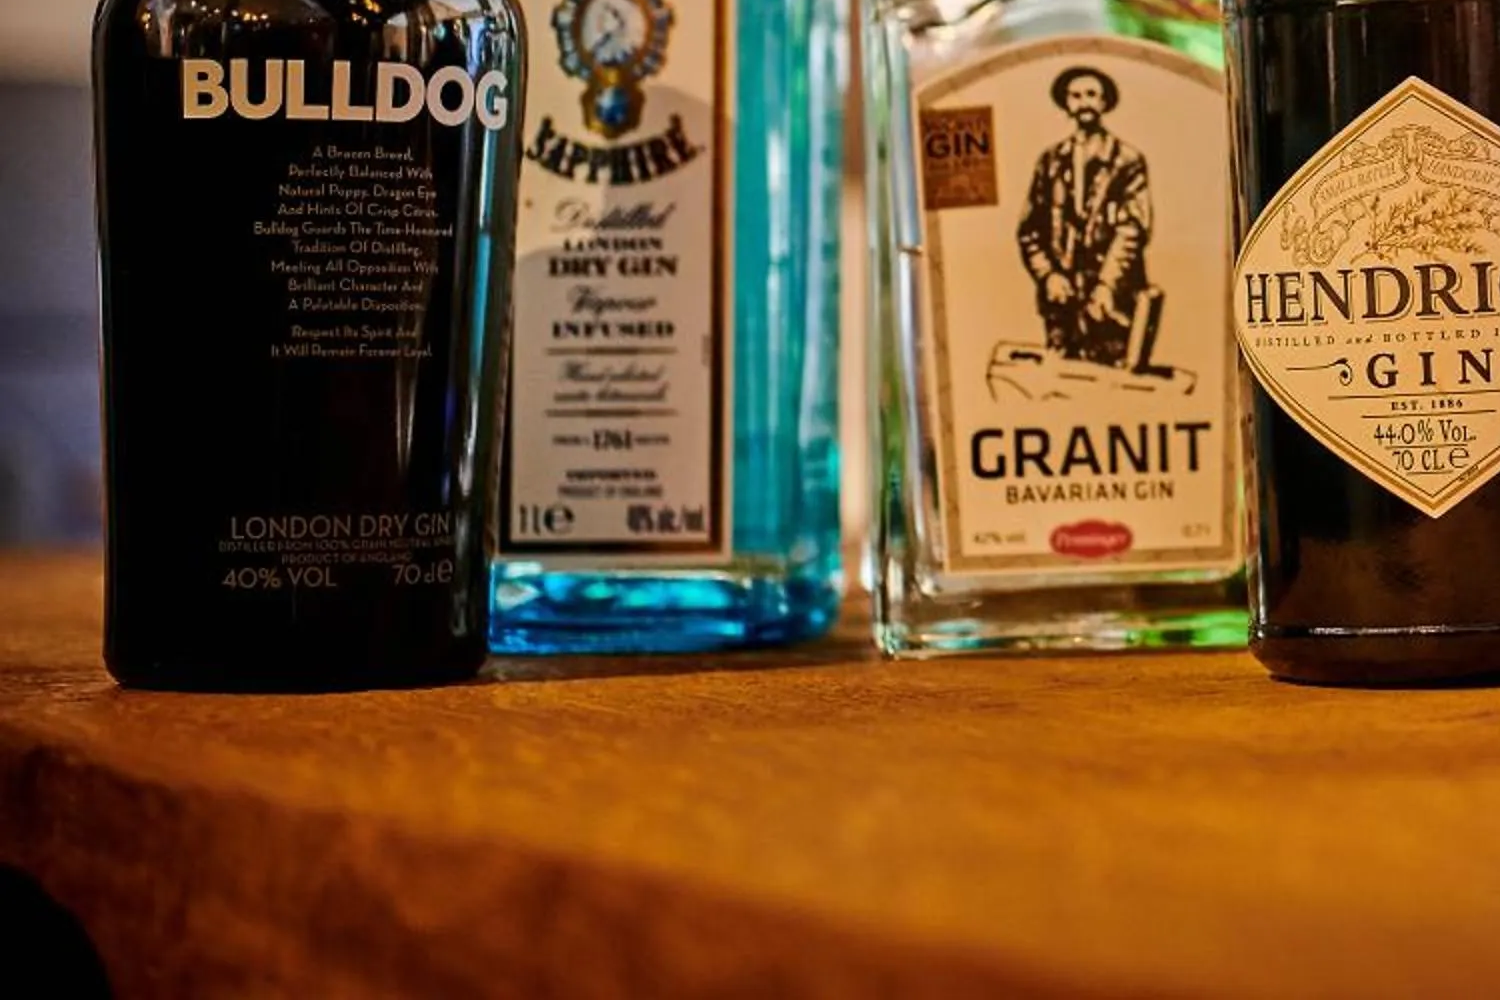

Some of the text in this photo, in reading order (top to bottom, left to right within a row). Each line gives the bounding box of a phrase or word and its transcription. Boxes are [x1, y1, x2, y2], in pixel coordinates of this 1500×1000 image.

[182, 58, 508, 131] BULLDOG
[312, 145, 323, 159] A
[525, 113, 705, 186] SAPPHIRE
[926, 131, 990, 159] GIN
[288, 163, 345, 179] Perfectly
[349, 164, 404, 179] Balanced
[278, 184, 325, 198] Natural
[307, 203, 341, 216] Hints
[344, 202, 363, 216] Of
[253, 221, 299, 238] Bulldog
[301, 221, 347, 236] Guards
[350, 222, 372, 236] The
[349, 240, 367, 254] Of
[271, 260, 321, 275] Meeting
[325, 259, 343, 272] All
[549, 255, 680, 277] DRY GIN
[288, 298, 298, 311] A
[553, 321, 676, 338] INFUSED
[1255, 336, 1335, 348] DISTILLED
[1346, 334, 1373, 345] and
[1383, 329, 1481, 343] BOTTLED
[283, 343, 309, 357] Will
[1366, 348, 1493, 388] GIN
[1391, 400, 1423, 411] EST.
[970, 422, 1211, 479] GRANIT
[1392, 450, 1414, 471] 70
[1006, 482, 1175, 505] BAVARIAN GIN
[230, 512, 450, 539] LONDON DRY GIN
[221, 566, 338, 590] 40% VOL
